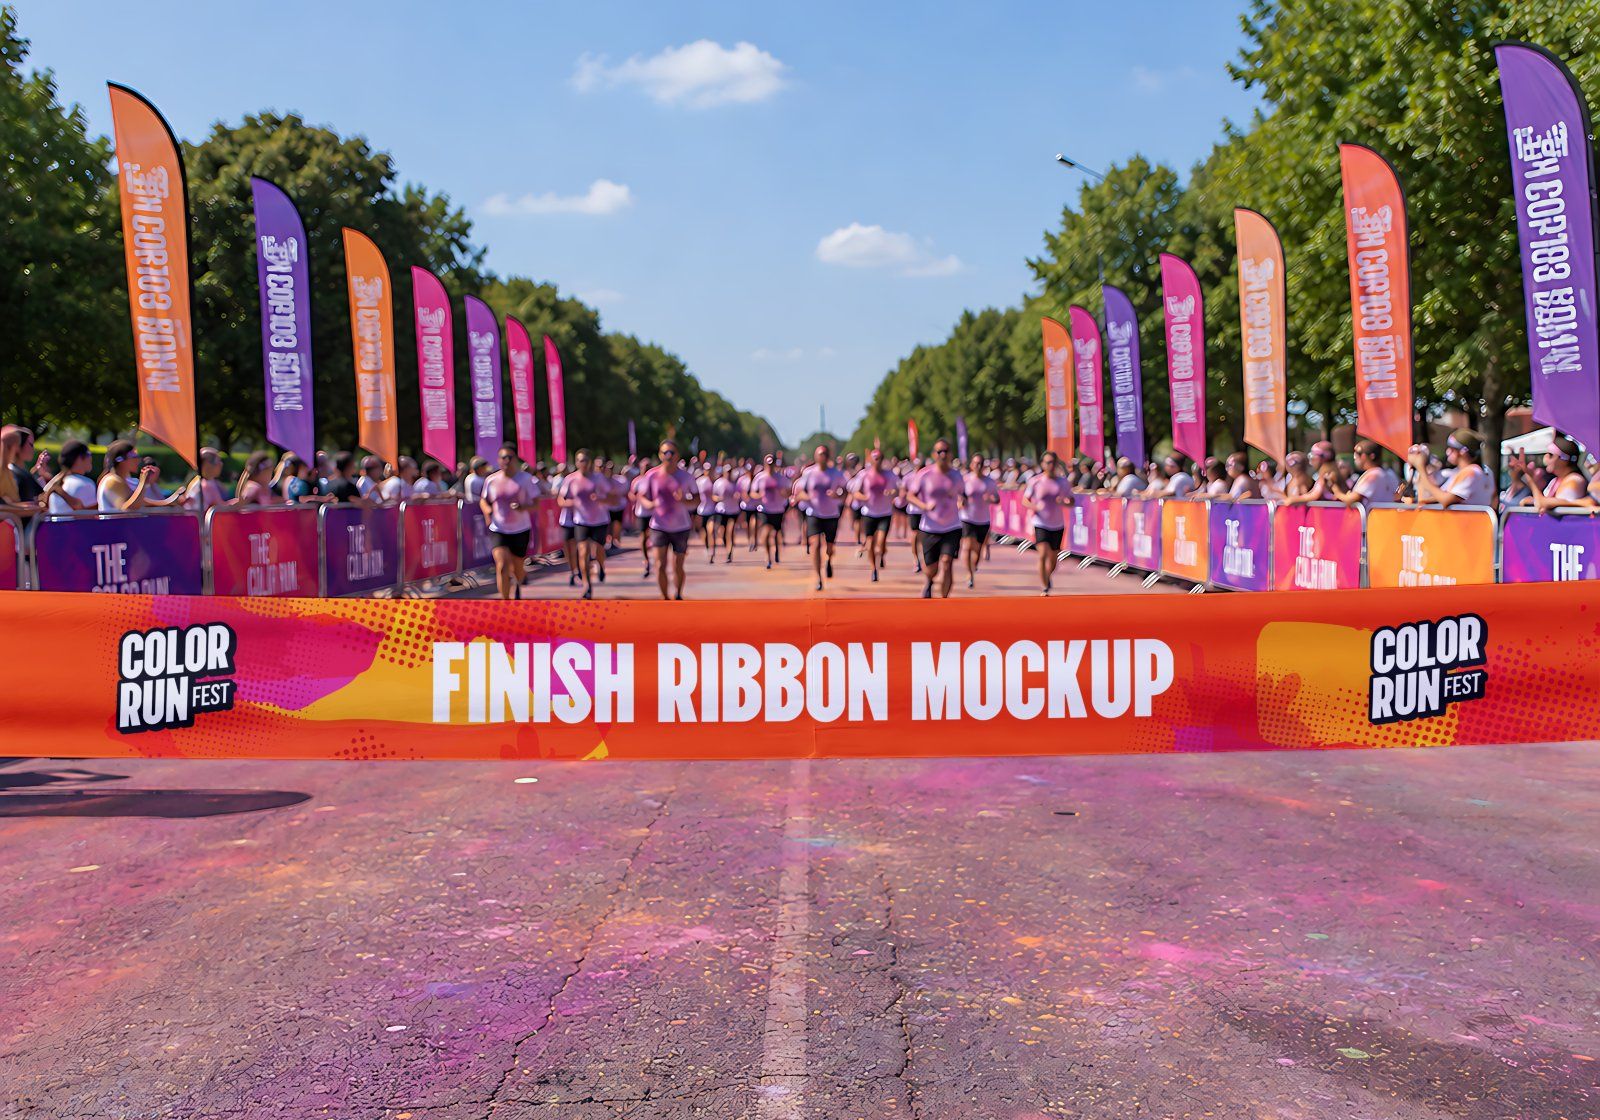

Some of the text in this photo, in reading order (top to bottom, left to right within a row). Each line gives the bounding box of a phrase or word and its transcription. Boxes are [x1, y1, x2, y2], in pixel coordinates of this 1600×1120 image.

[92, 543, 127, 585] THE
[121, 625, 230, 680] COLOR
[1373, 616, 1481, 674] COLOR
[119, 675, 231, 728] RUN FEST
[432, 638, 1175, 724] FINISH RIBBON MOCKUP
[1371, 667, 1482, 720] RUN FEST
